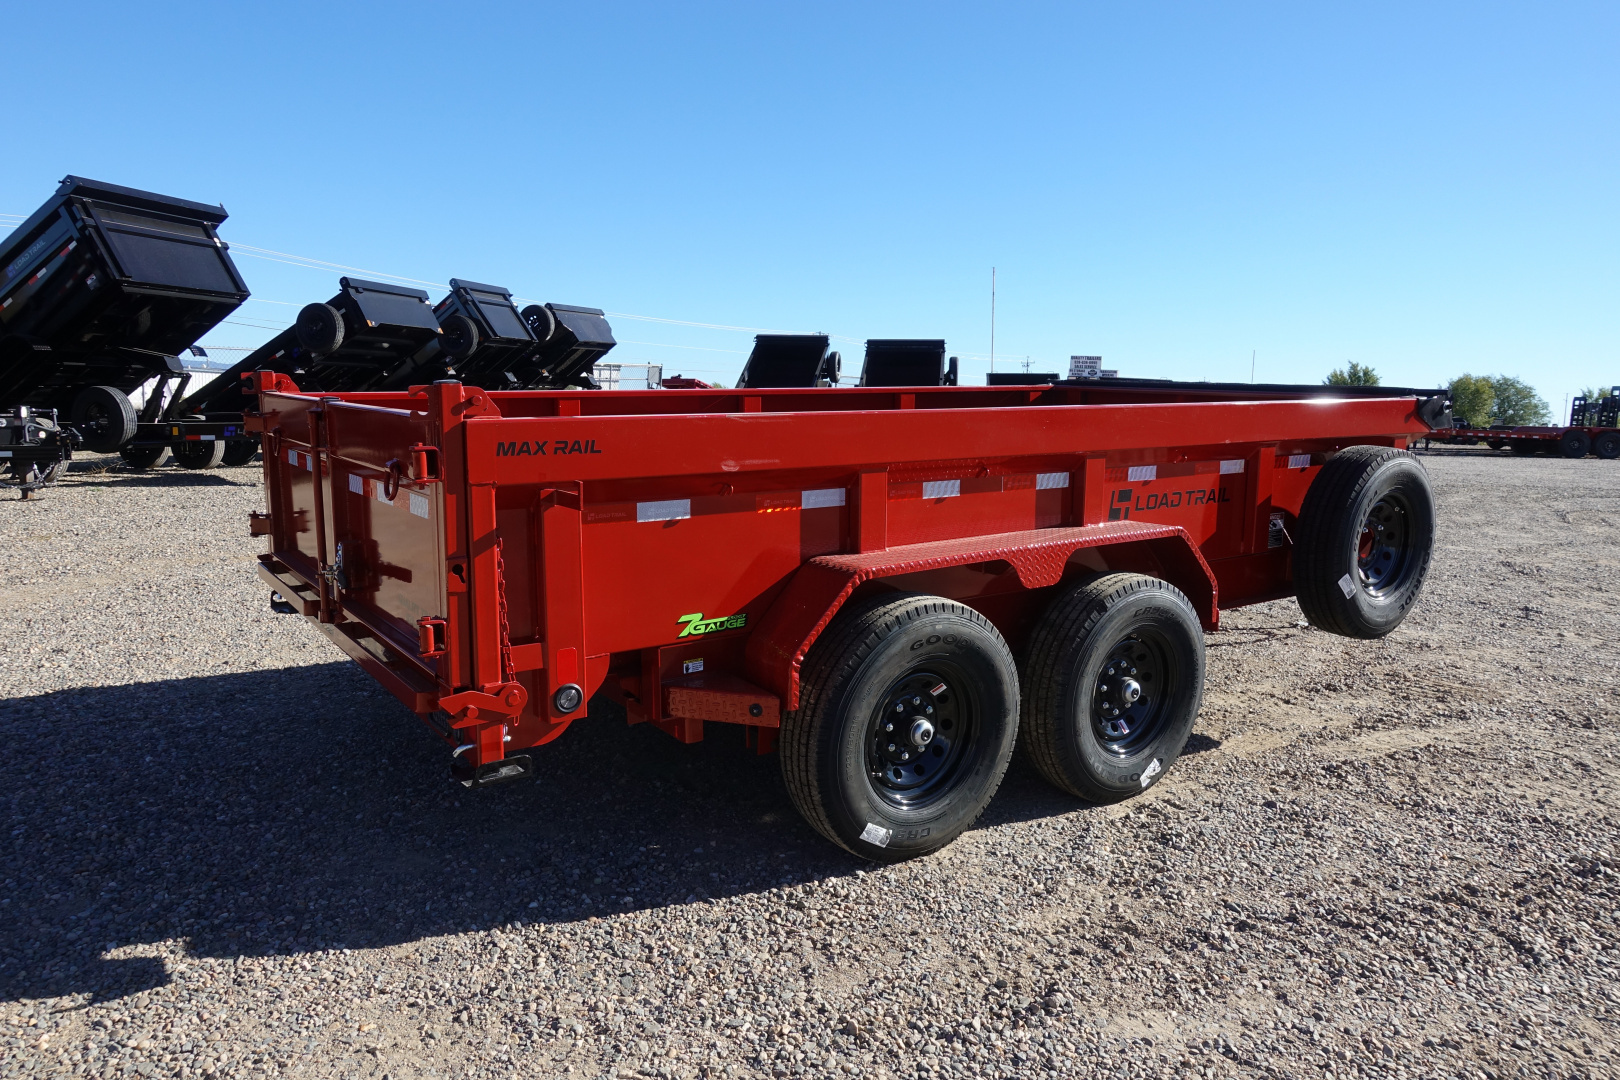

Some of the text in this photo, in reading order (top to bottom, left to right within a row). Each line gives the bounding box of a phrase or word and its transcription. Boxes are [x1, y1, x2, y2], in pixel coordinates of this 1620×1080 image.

[14, 239, 46, 269] LOAD TRAIL
[496, 439, 602, 457] MAX RAIL
[1134, 487, 1231, 512] LOAD TRAIL
[1086, 754, 1163, 784] ODRIDE
